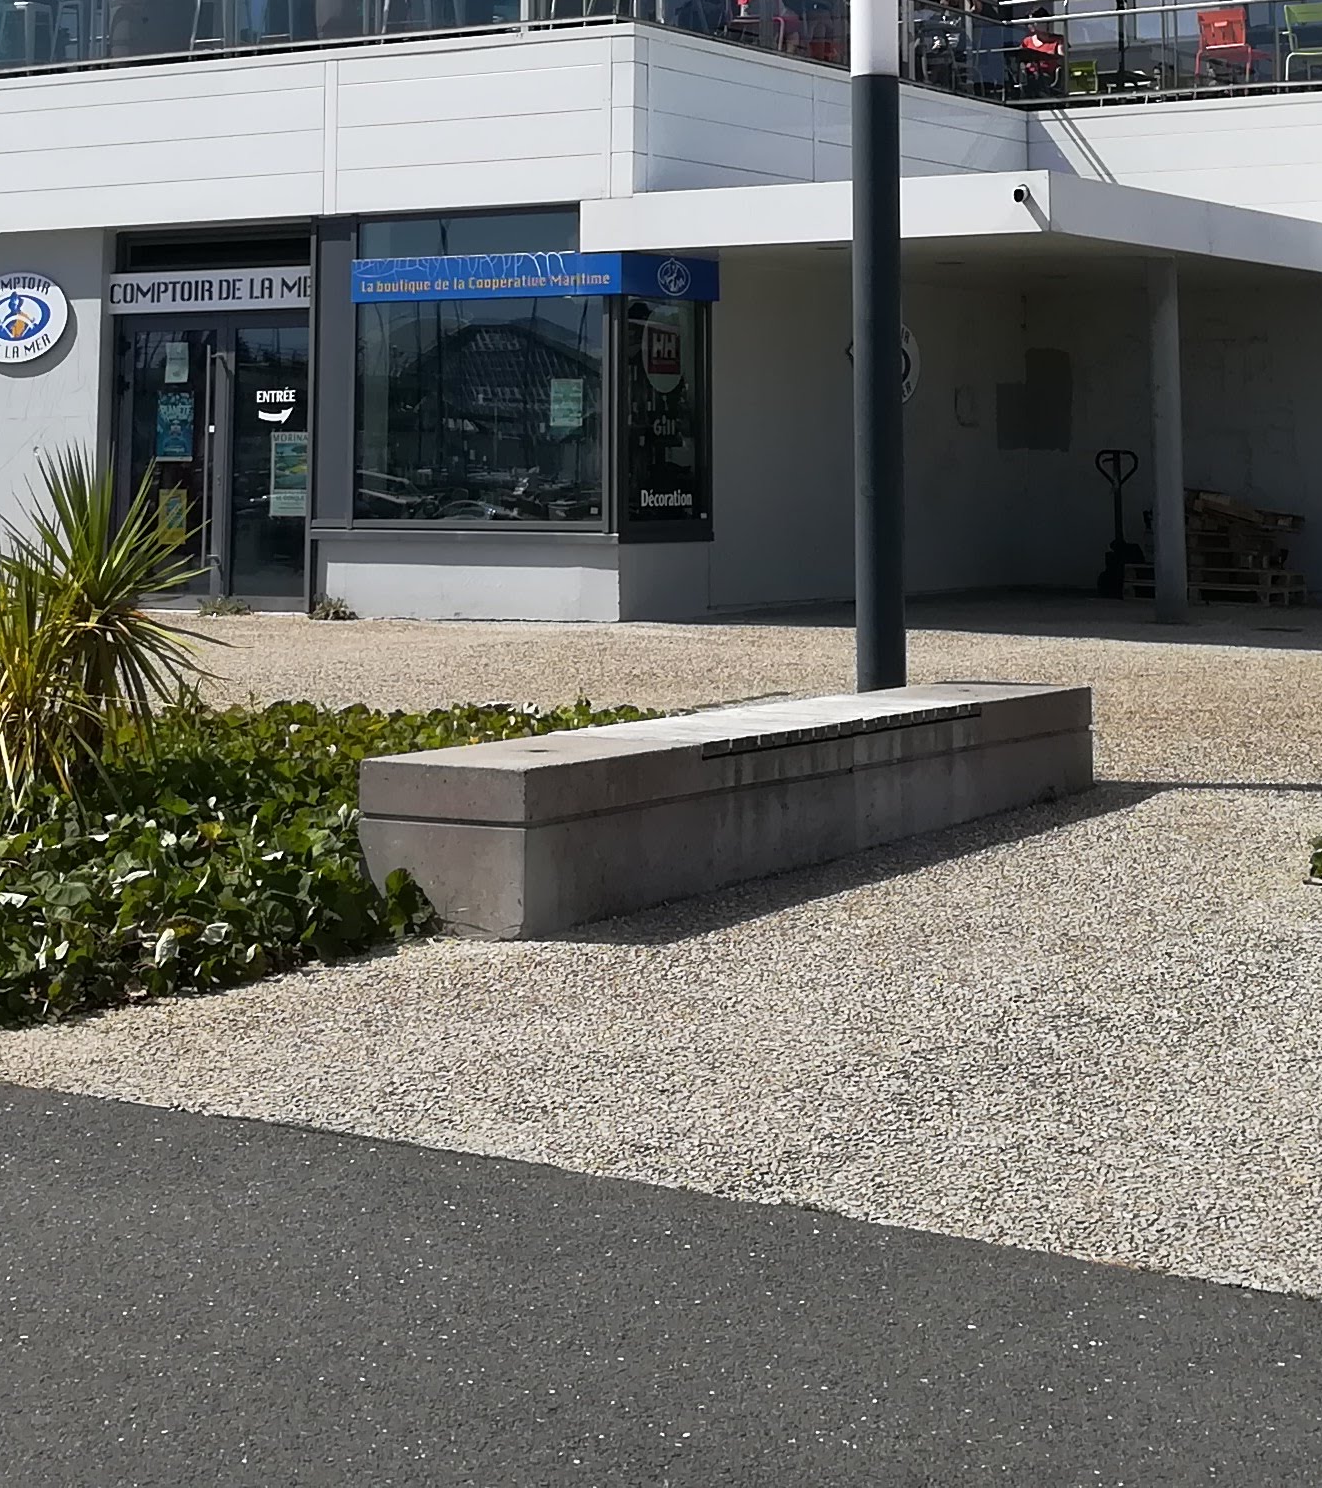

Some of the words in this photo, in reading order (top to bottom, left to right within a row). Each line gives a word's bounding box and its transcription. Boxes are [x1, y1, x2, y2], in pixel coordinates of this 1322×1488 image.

[109, 279, 213, 305] COMPTOIR
[218, 278, 243, 301] DE
[249, 277, 274, 300] LA
[279, 275, 311, 299] ME
[361, 281, 374, 293] La
[376, 279, 431, 294] boutique
[434, 278, 450, 291] de
[453, 277, 466, 290] la
[550, 272, 611, 287] Maritime
[5, 346, 20, 359] LA
[24, 333, 52, 357] MER
[256, 386, 297, 403] ENTRÉE
[640, 489, 693, 507] Décoration
